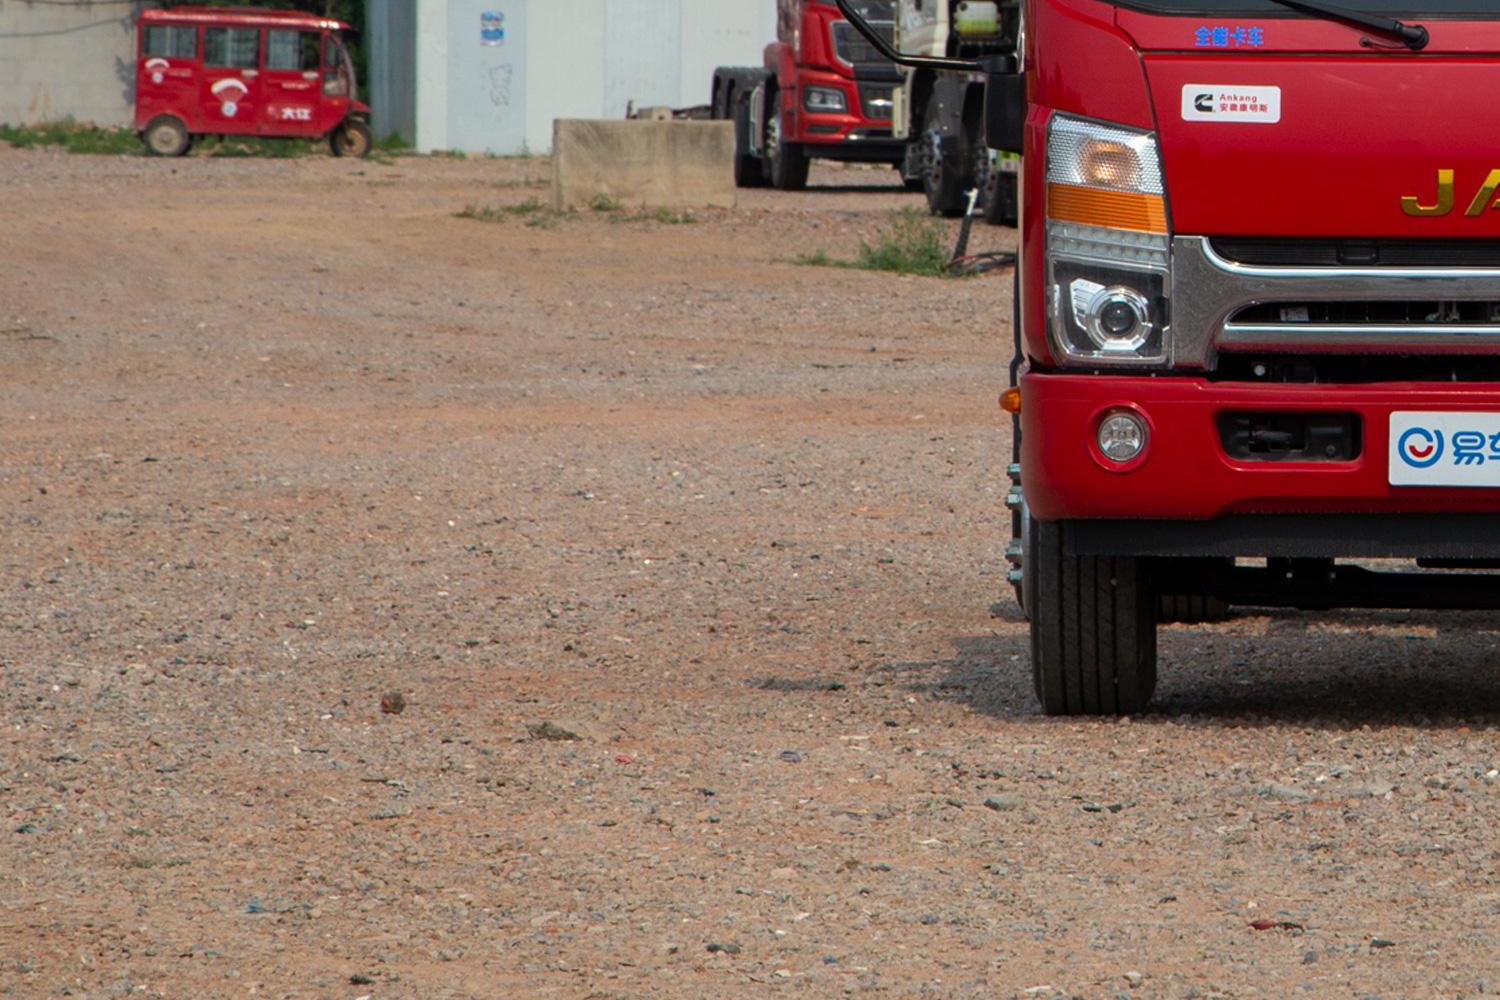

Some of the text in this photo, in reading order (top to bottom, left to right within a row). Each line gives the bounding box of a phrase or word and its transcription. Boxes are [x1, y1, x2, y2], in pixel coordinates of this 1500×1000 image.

[1194, 25, 1265, 48] 全能卡车
[1220, 93, 1258, 103] Ankang
